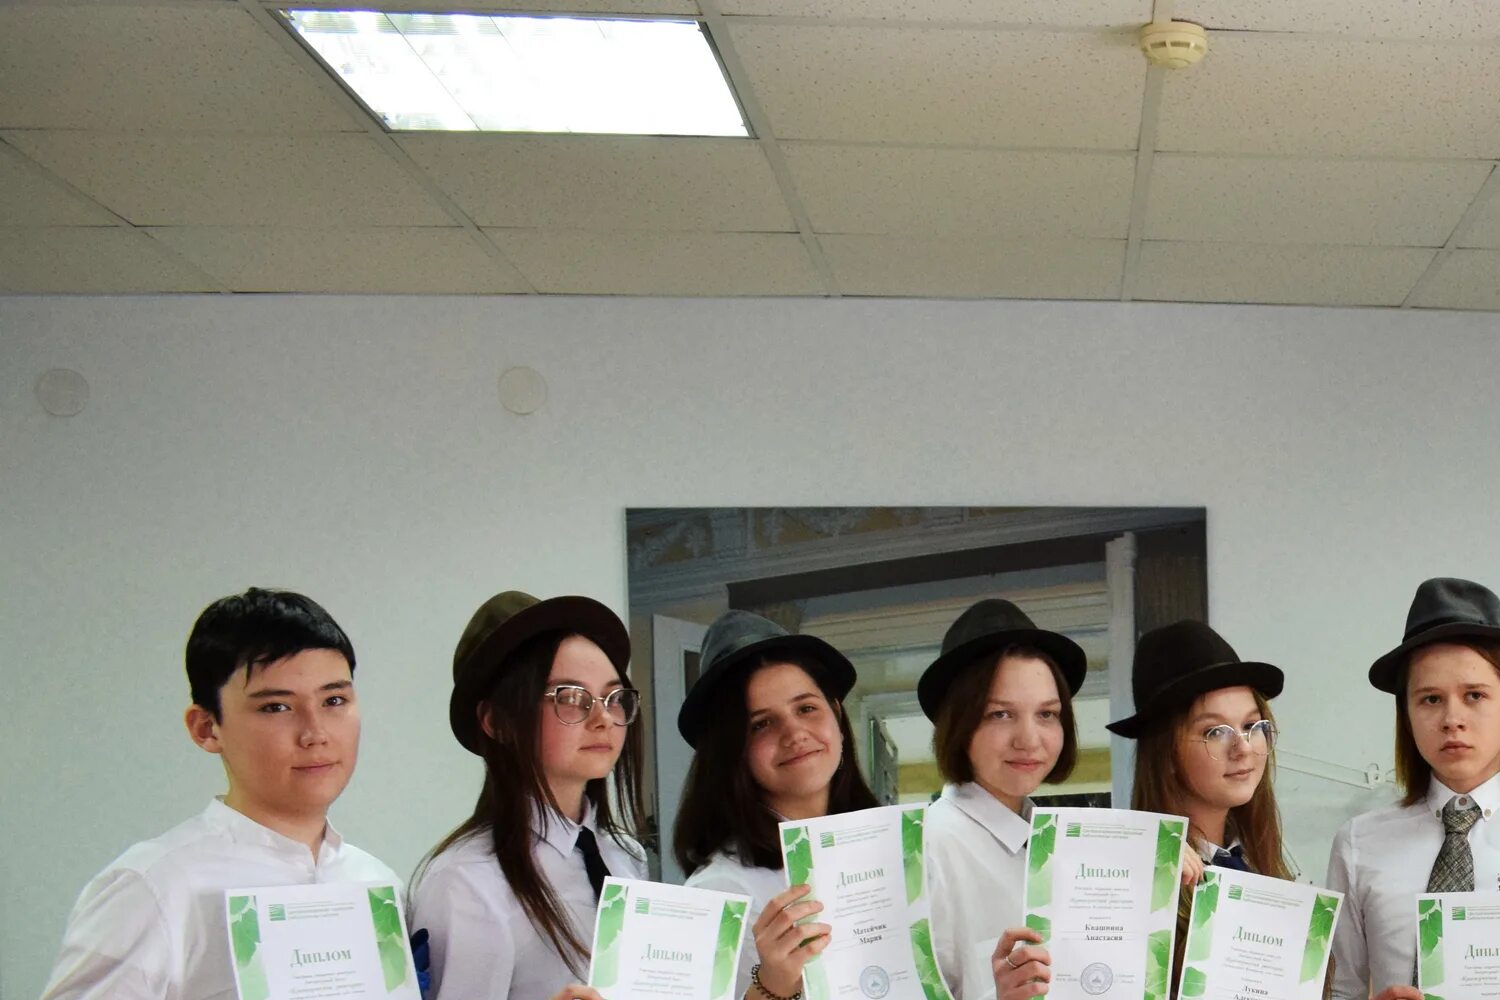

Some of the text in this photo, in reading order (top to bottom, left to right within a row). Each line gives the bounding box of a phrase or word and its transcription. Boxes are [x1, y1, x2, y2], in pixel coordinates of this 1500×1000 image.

[837, 867, 884, 888] Диплом
[1075, 863, 1130, 880] Диплом
[1084, 934, 1123, 942] Анастасия
[1232, 926, 1283, 947] Диплом
[290, 948, 352, 968] Диплом
[641, 943, 692, 962] Диплом
